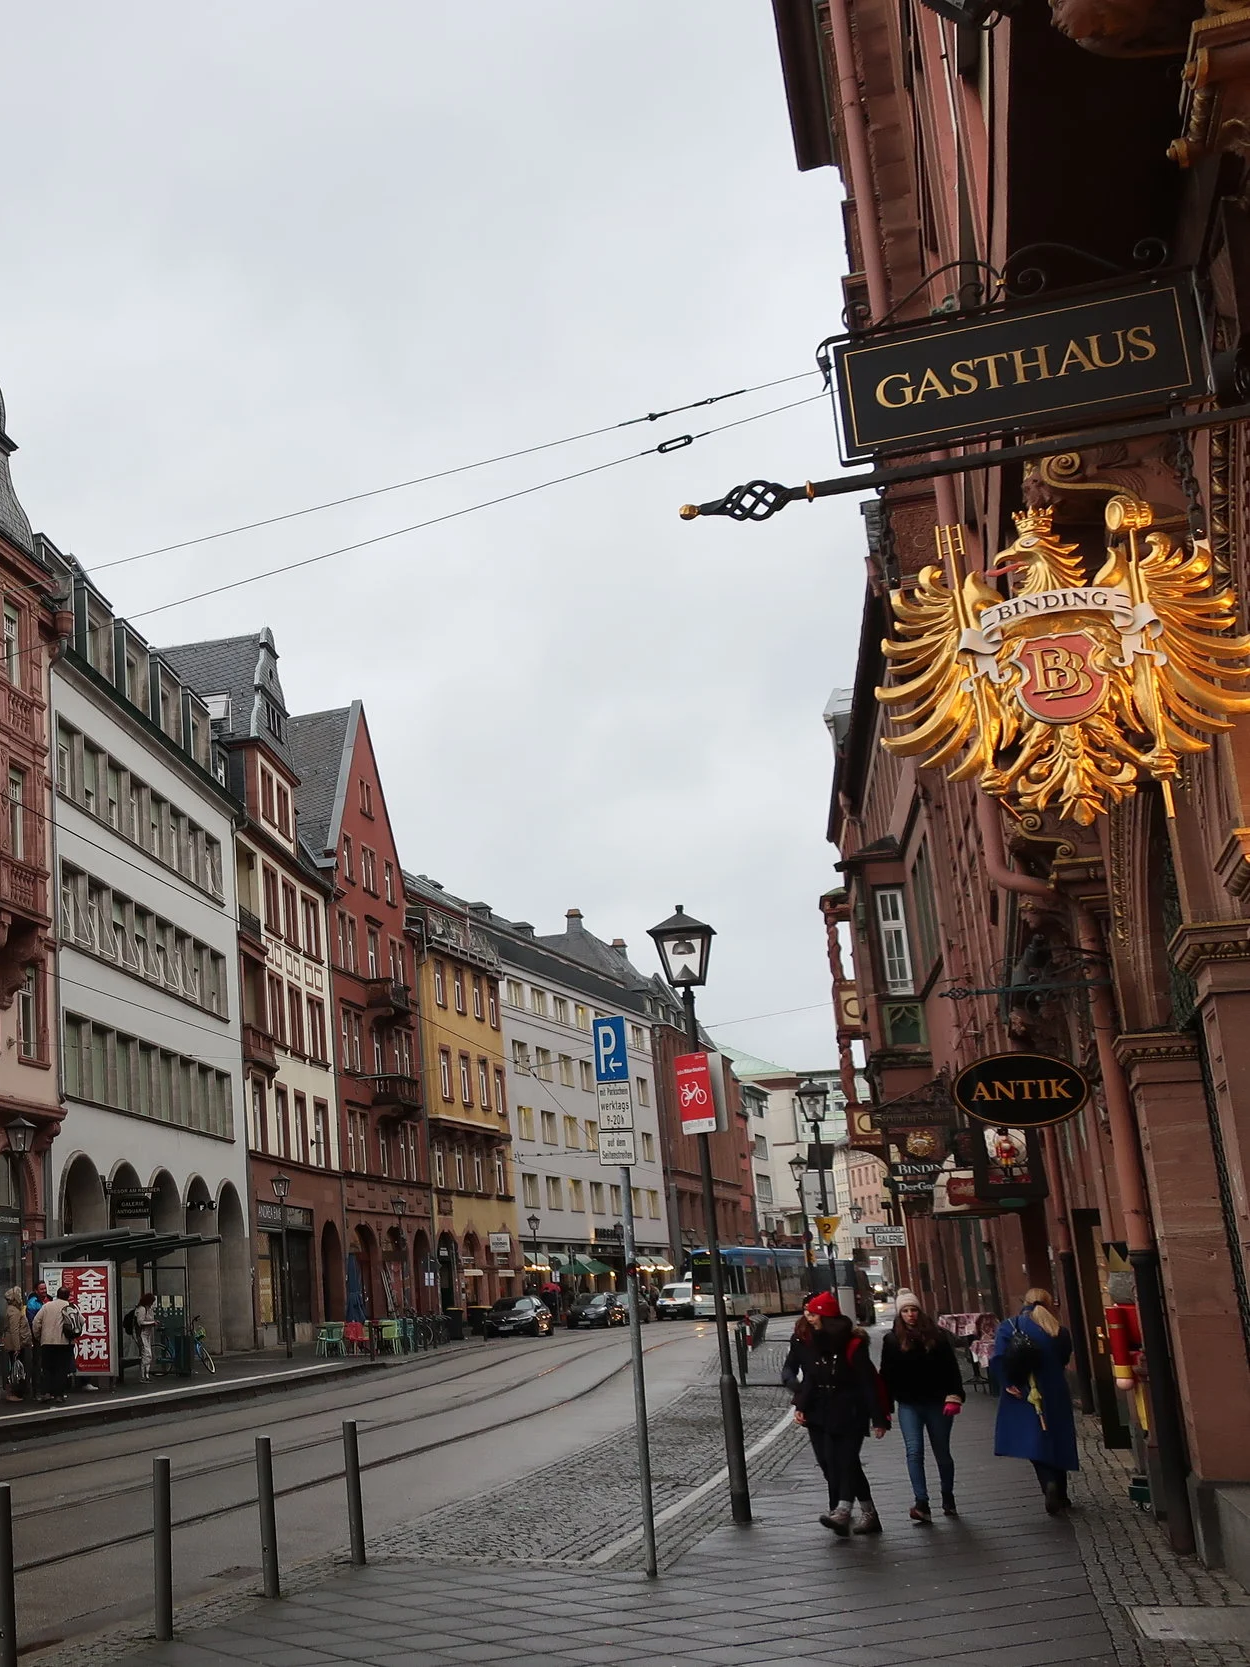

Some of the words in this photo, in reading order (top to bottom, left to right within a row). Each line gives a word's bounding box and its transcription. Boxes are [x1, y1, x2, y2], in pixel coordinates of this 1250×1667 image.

[875, 325, 1157, 409] GASTHAUS
[996, 590, 1109, 621] BINDING
[598, 1025, 616, 1074] P
[971, 1078, 1073, 1101] ANTIK
[600, 1100, 630, 1112] werktags
[607, 1138, 615, 1147] auf
[616, 1137, 626, 1147] dem
[602, 1150, 633, 1160] Seitenstreifen
[823, 1223, 832, 1234] 2
[877, 1235, 903, 1244] GALERIE
[76, 1268, 109, 1361] 全额退税
